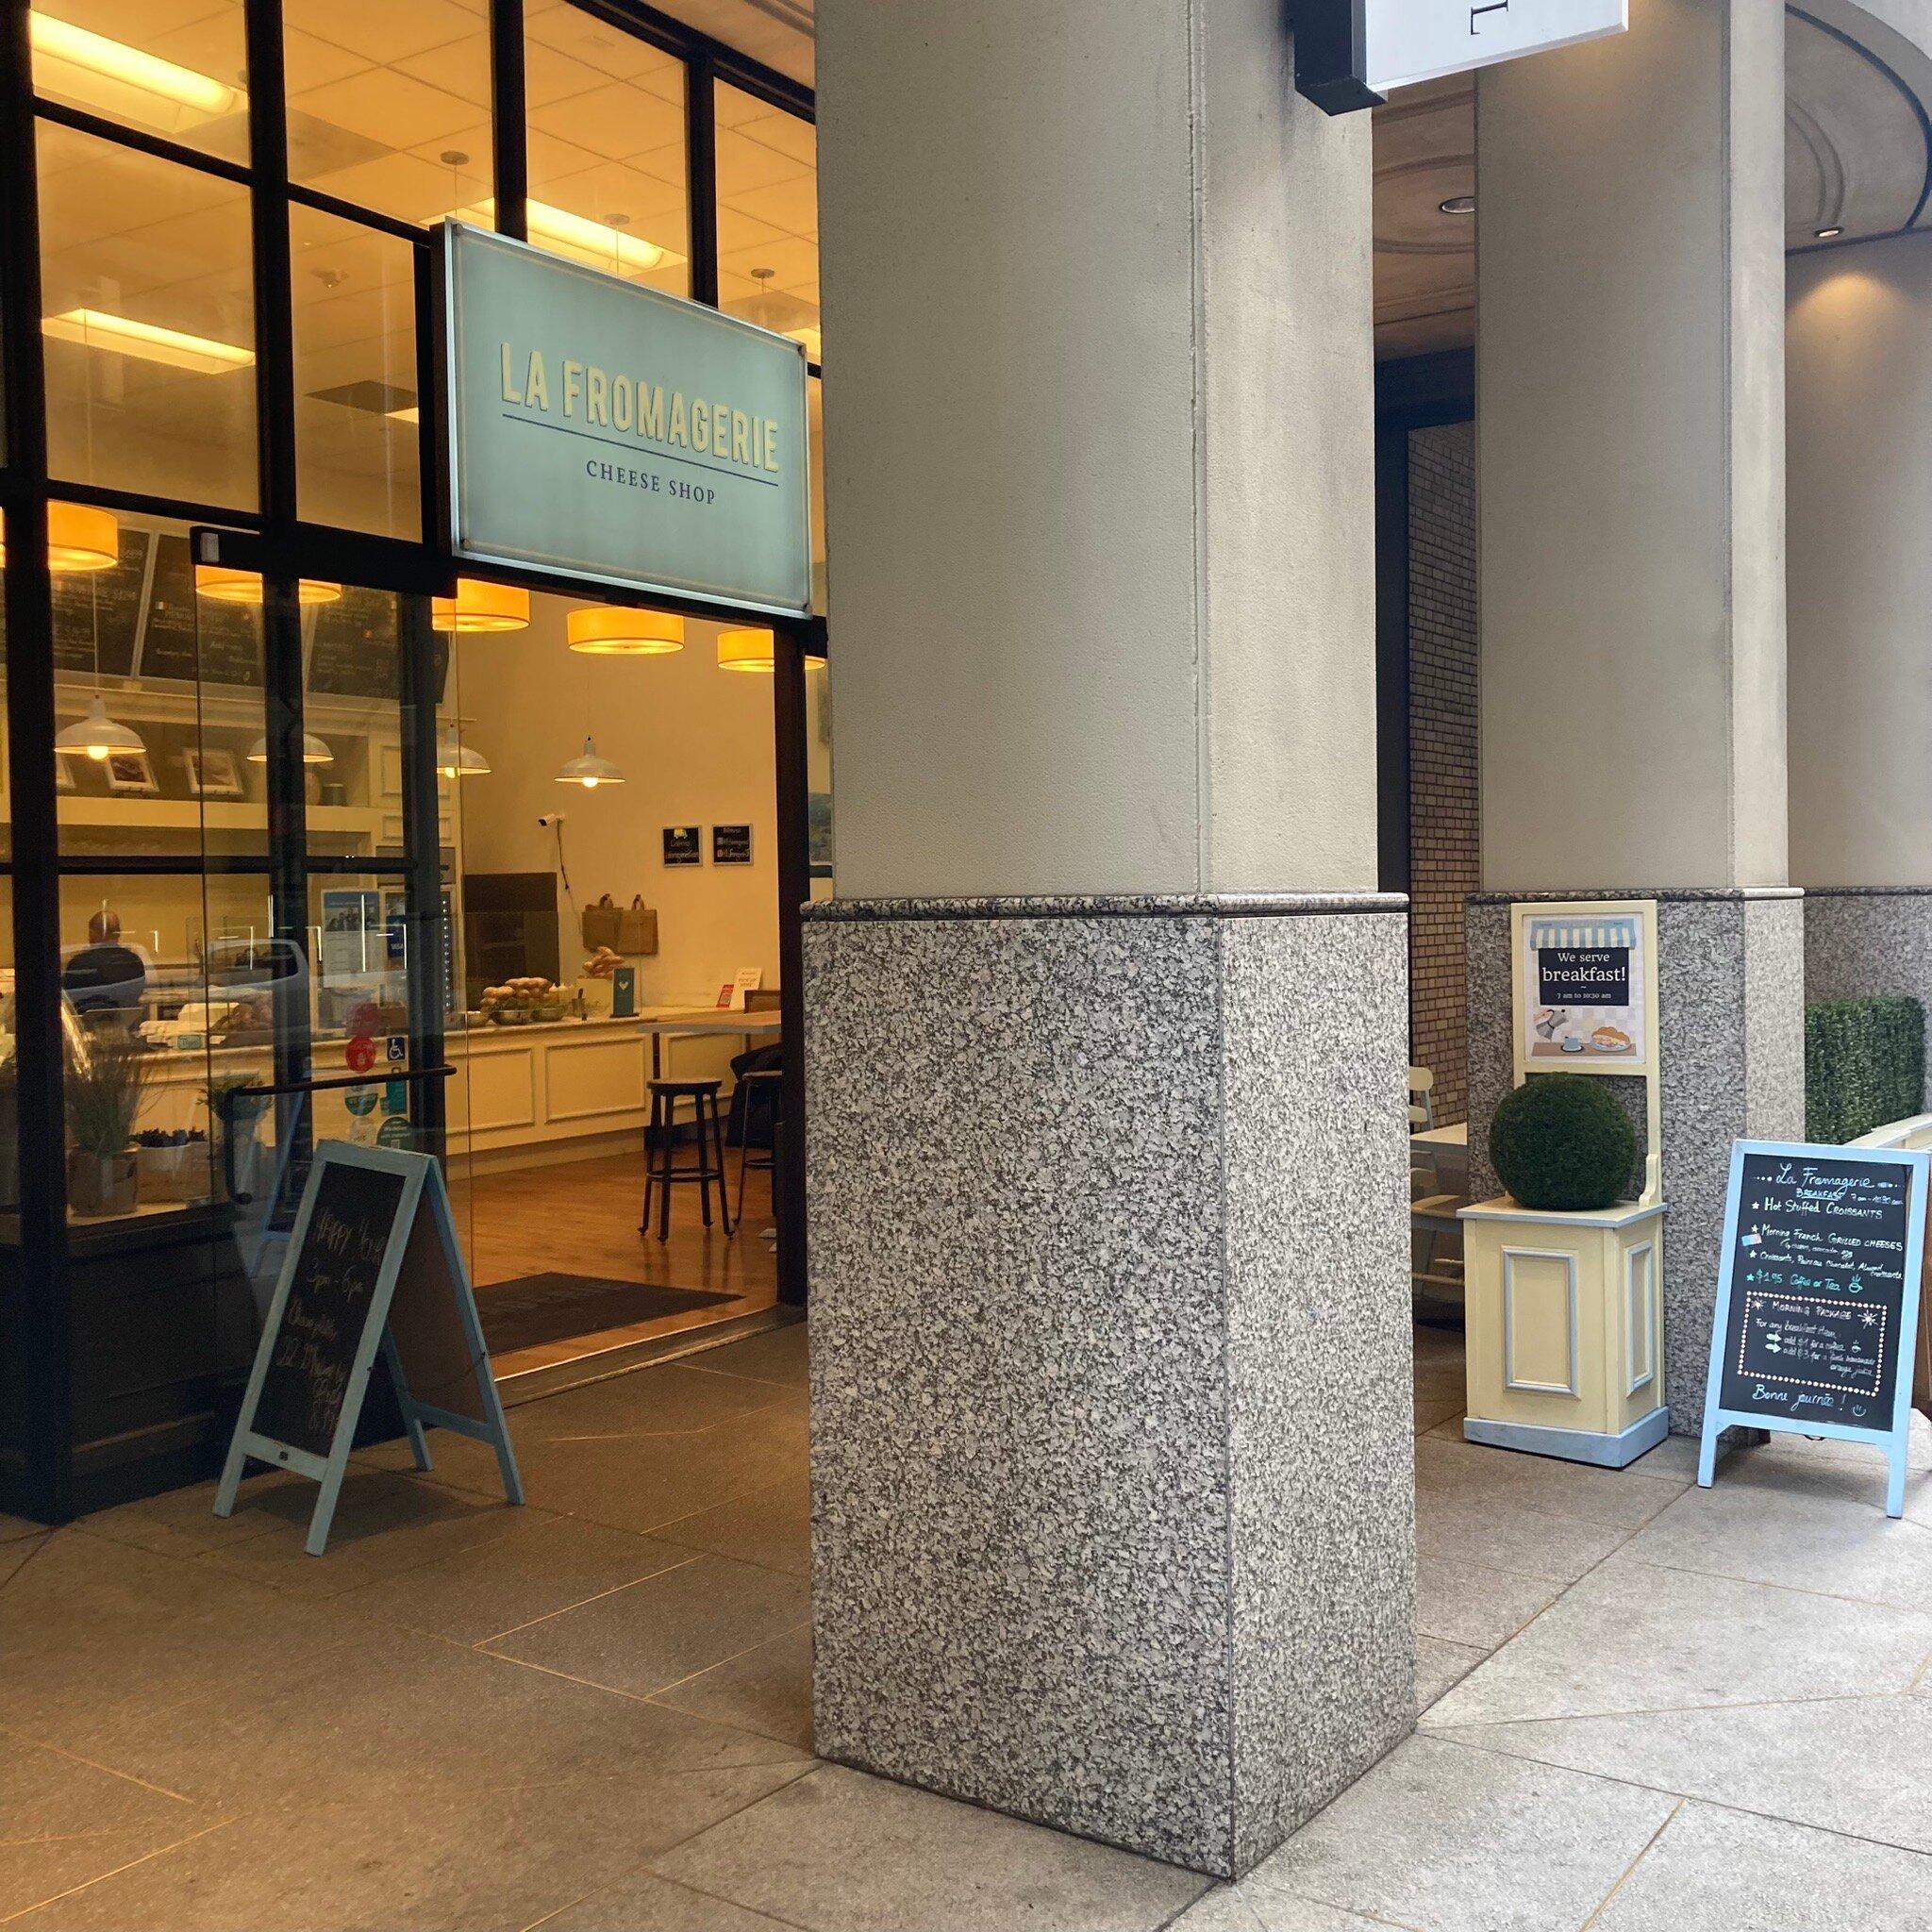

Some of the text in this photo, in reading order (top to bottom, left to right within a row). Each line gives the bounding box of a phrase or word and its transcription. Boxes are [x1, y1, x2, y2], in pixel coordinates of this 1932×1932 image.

[500, 341, 779, 474] LA FROMAGERIE
[586, 458, 716, 506] CHEESE SHOP
[1557, 952, 1610, 962] We serve
[1541, 966, 1625, 982] breakfast!
[1775, 1162, 1797, 1185] La
[1764, 1197, 1883, 1220] Hot Stuffed CROISSANTS
[1828, 1232, 1861, 1247] GRILLED
[1863, 1240, 1904, 1252] CHEESES
[1824, 1278, 1841, 1291] Tea
[1752, 1383, 1788, 1401] Bonne
